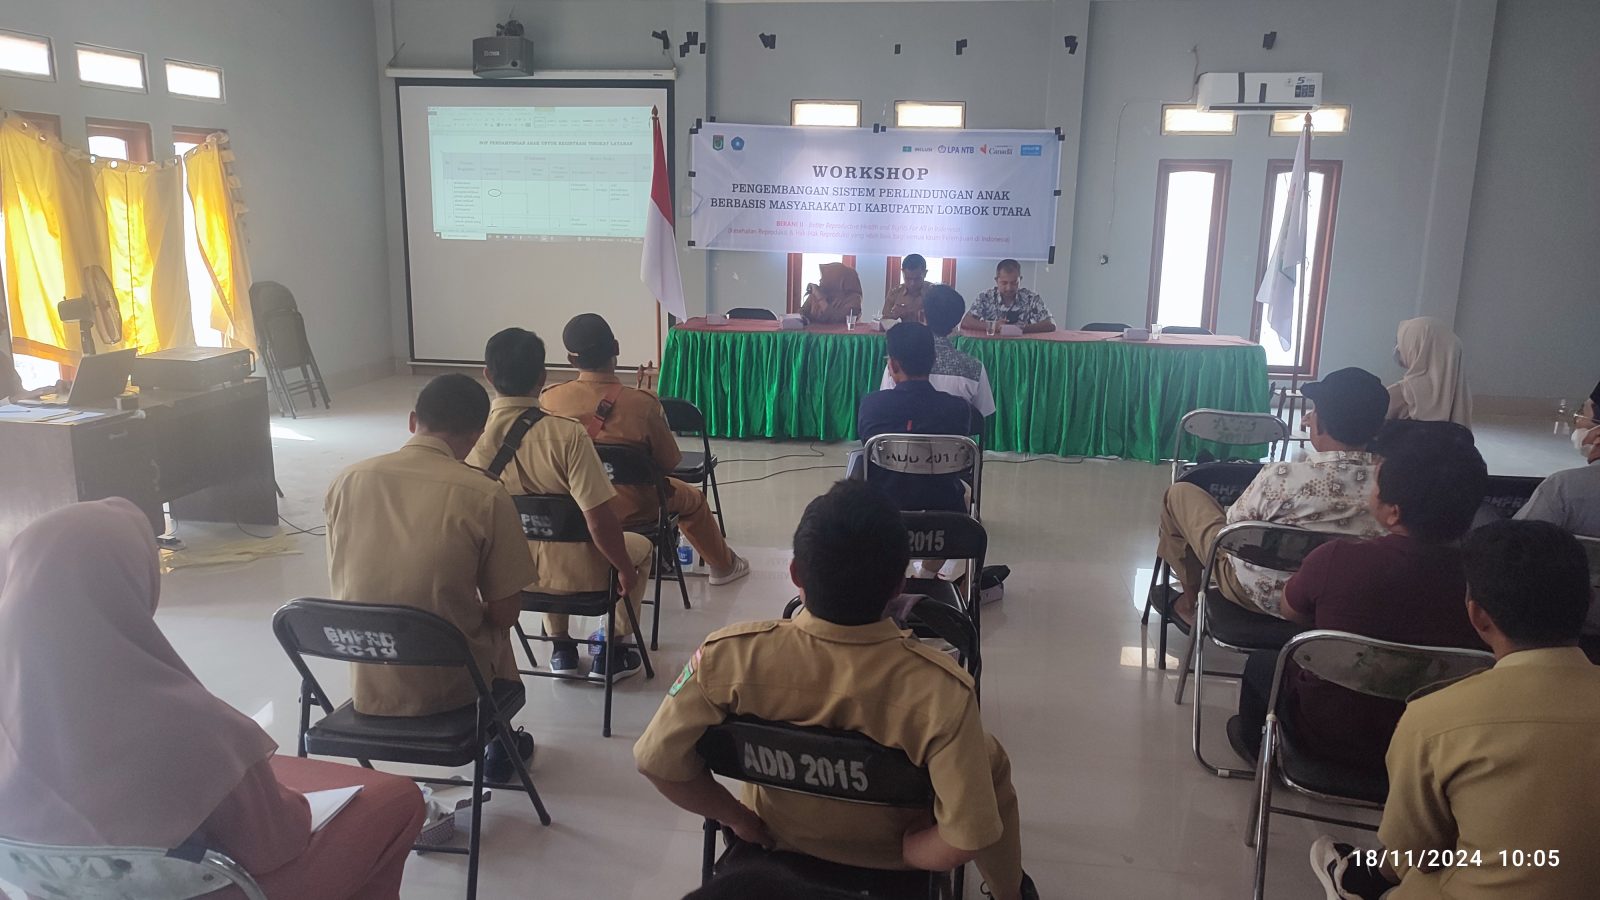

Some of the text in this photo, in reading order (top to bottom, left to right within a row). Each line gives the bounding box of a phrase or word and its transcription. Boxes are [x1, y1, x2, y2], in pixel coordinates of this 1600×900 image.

[947, 145, 975, 154] LPA NTB
[813, 165, 929, 181] WORKSHOP
[732, 183, 1011, 201] PENGEMBANGAN SISTEM PERLINDUNGAN ANAK
[710, 197, 1031, 217] BERBASIS MASYARAKAT DI KABUPATEN LOMBOK UTARA
[907, 529, 945, 552] 2015
[743, 741, 869, 792] ADD 2015
